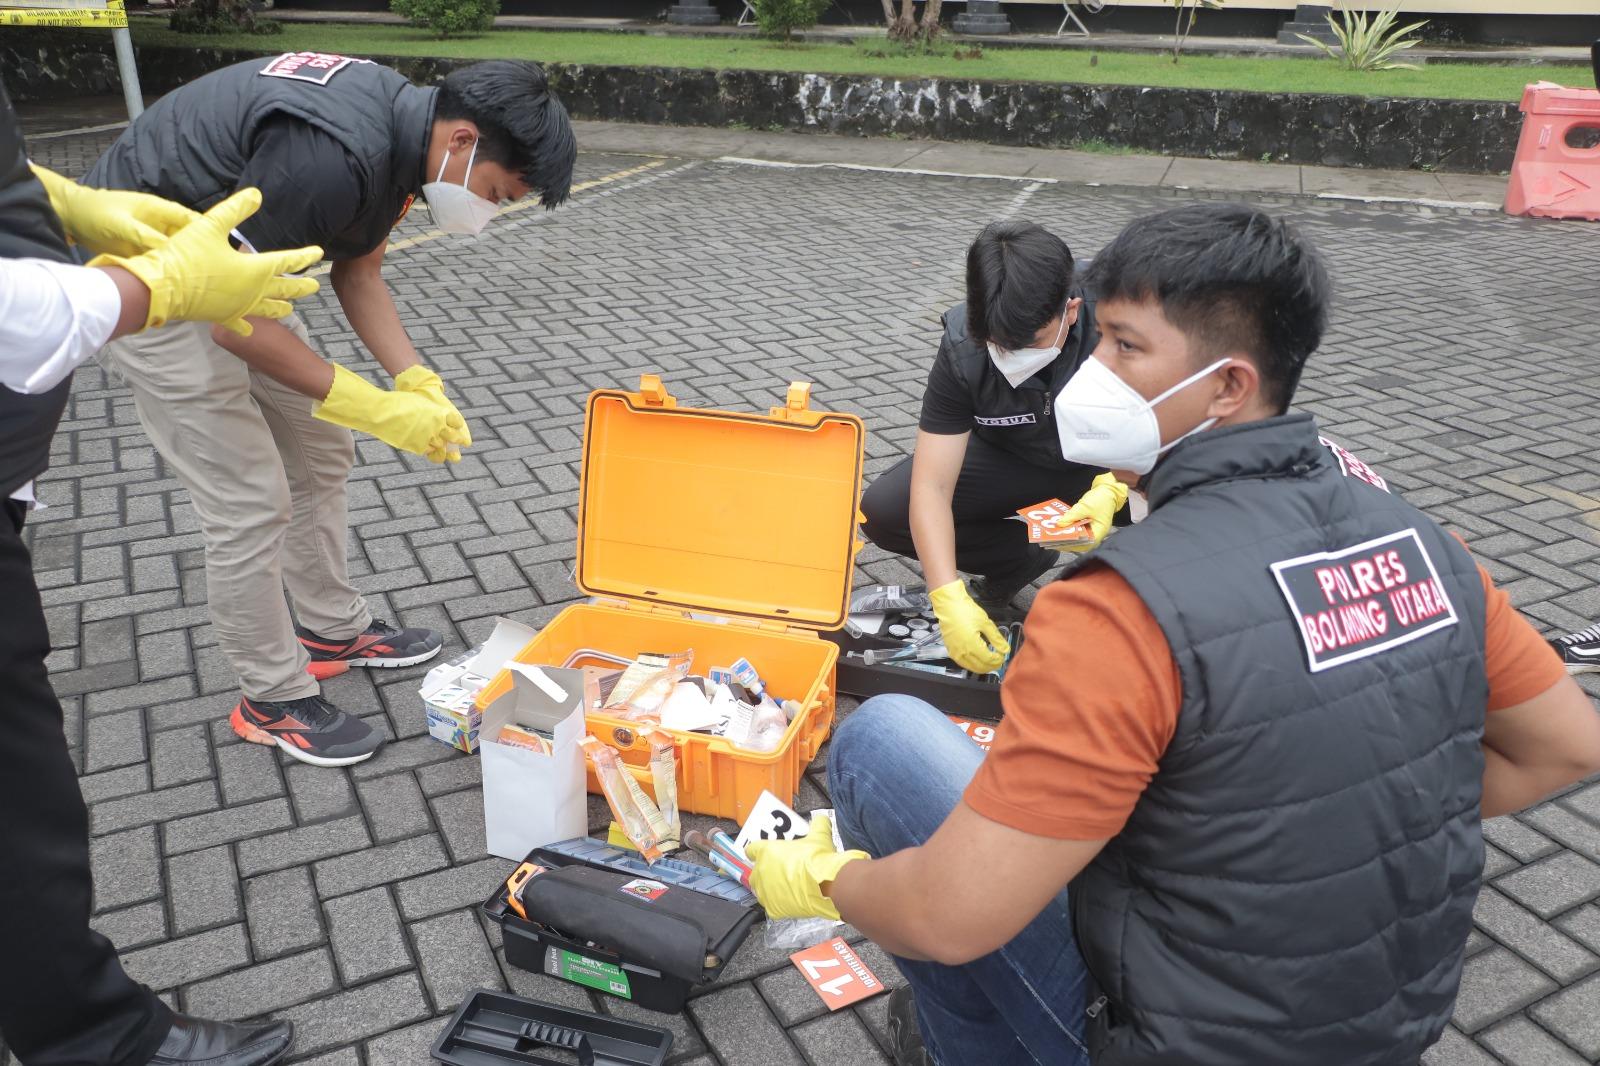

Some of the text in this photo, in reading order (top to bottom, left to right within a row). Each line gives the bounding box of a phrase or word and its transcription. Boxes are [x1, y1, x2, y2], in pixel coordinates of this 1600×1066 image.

[981, 416, 1031, 425] YOSUA
[1389, 579, 1448, 627] UTARA
[800, 959, 854, 996] 17
[832, 942, 876, 988] IDENTIFIKASI
